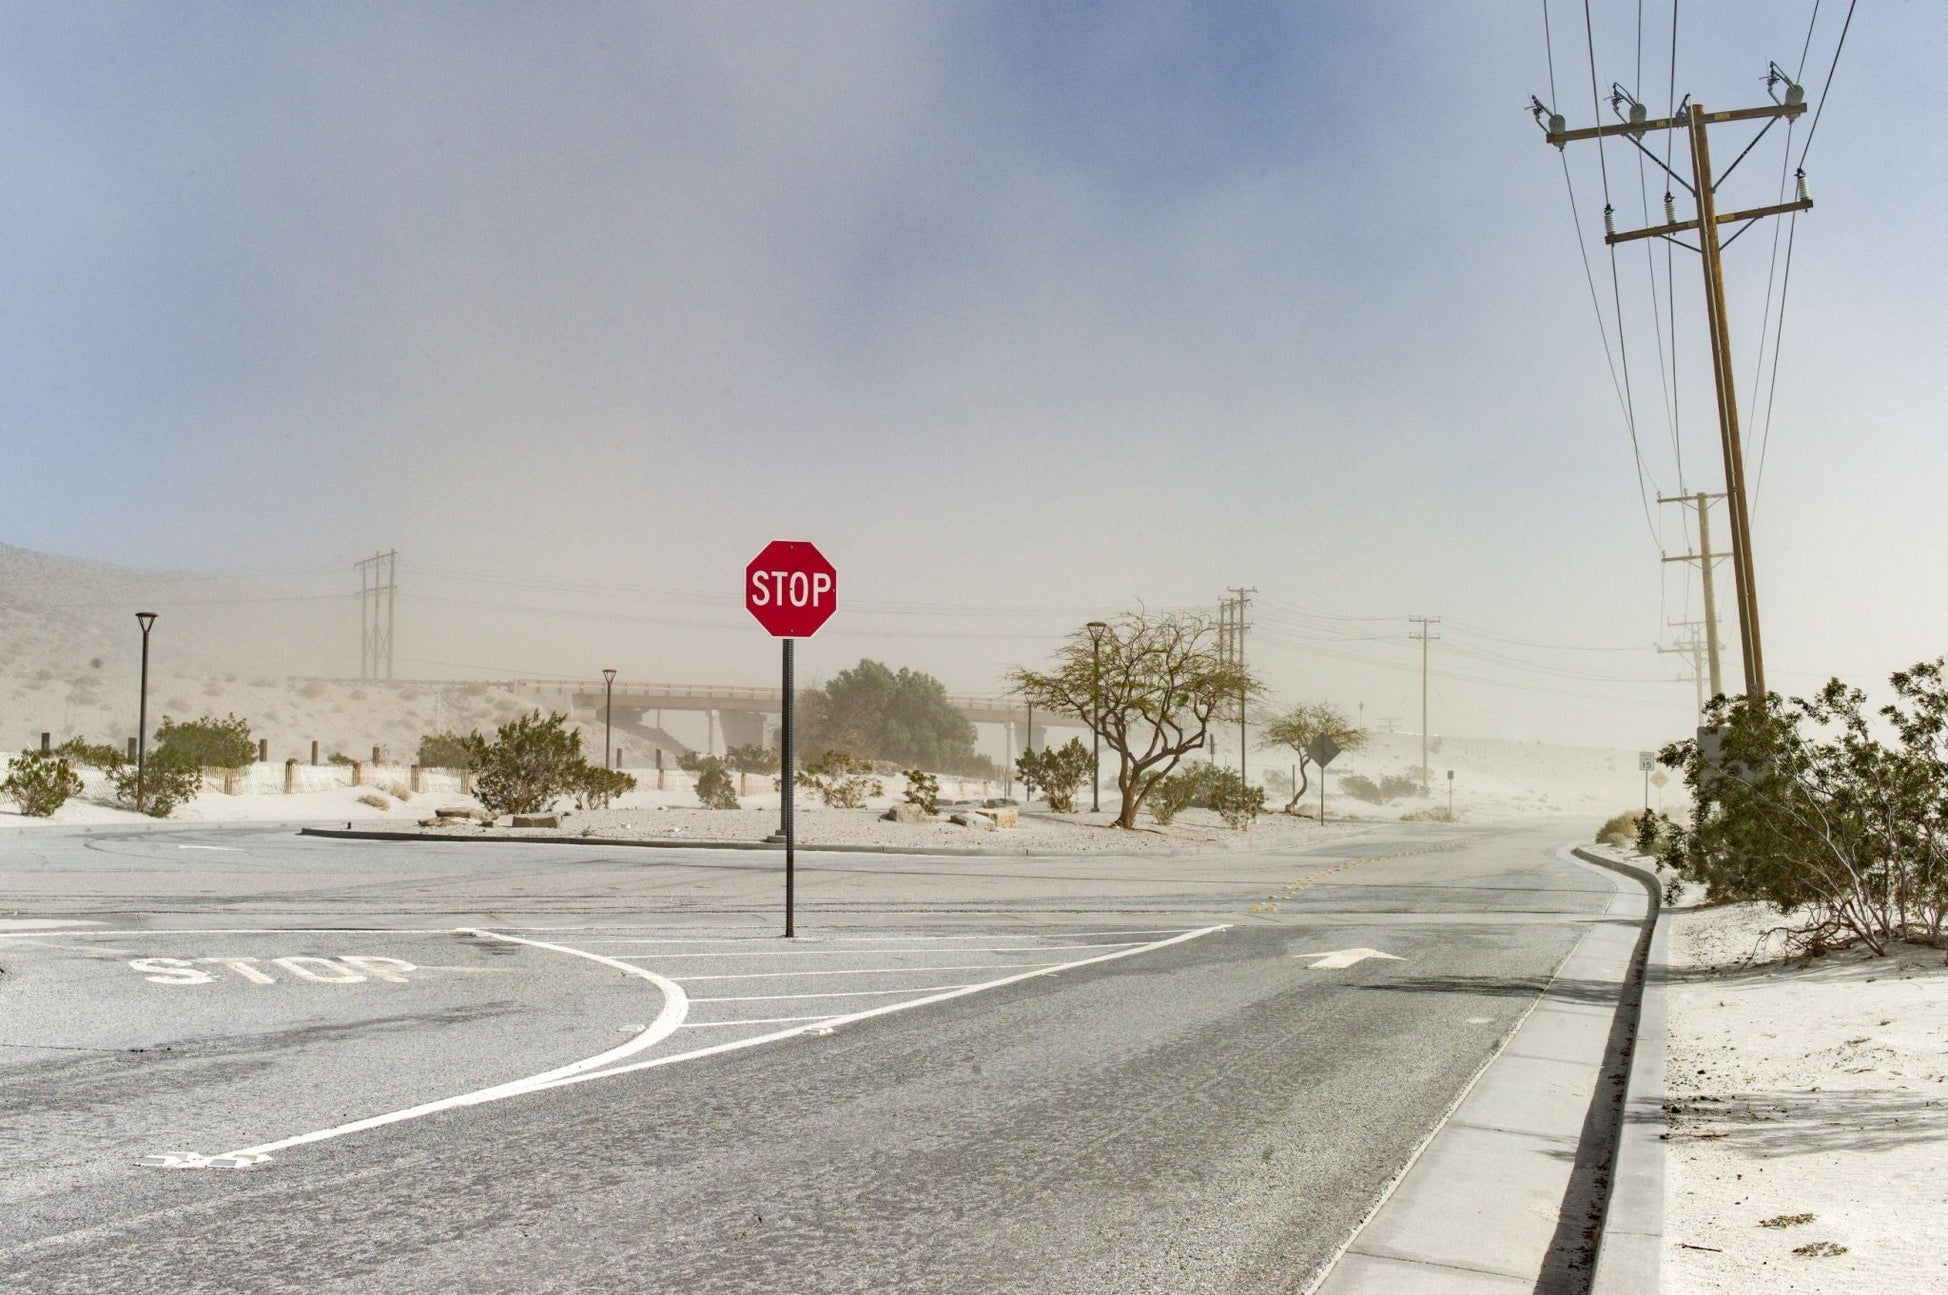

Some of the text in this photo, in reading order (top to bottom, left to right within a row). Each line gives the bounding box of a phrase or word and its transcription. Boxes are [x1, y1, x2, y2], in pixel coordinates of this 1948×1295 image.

[752, 570, 832, 607] STOP
[1642, 761, 1652, 769] 15
[128, 956, 418, 984] STOP
